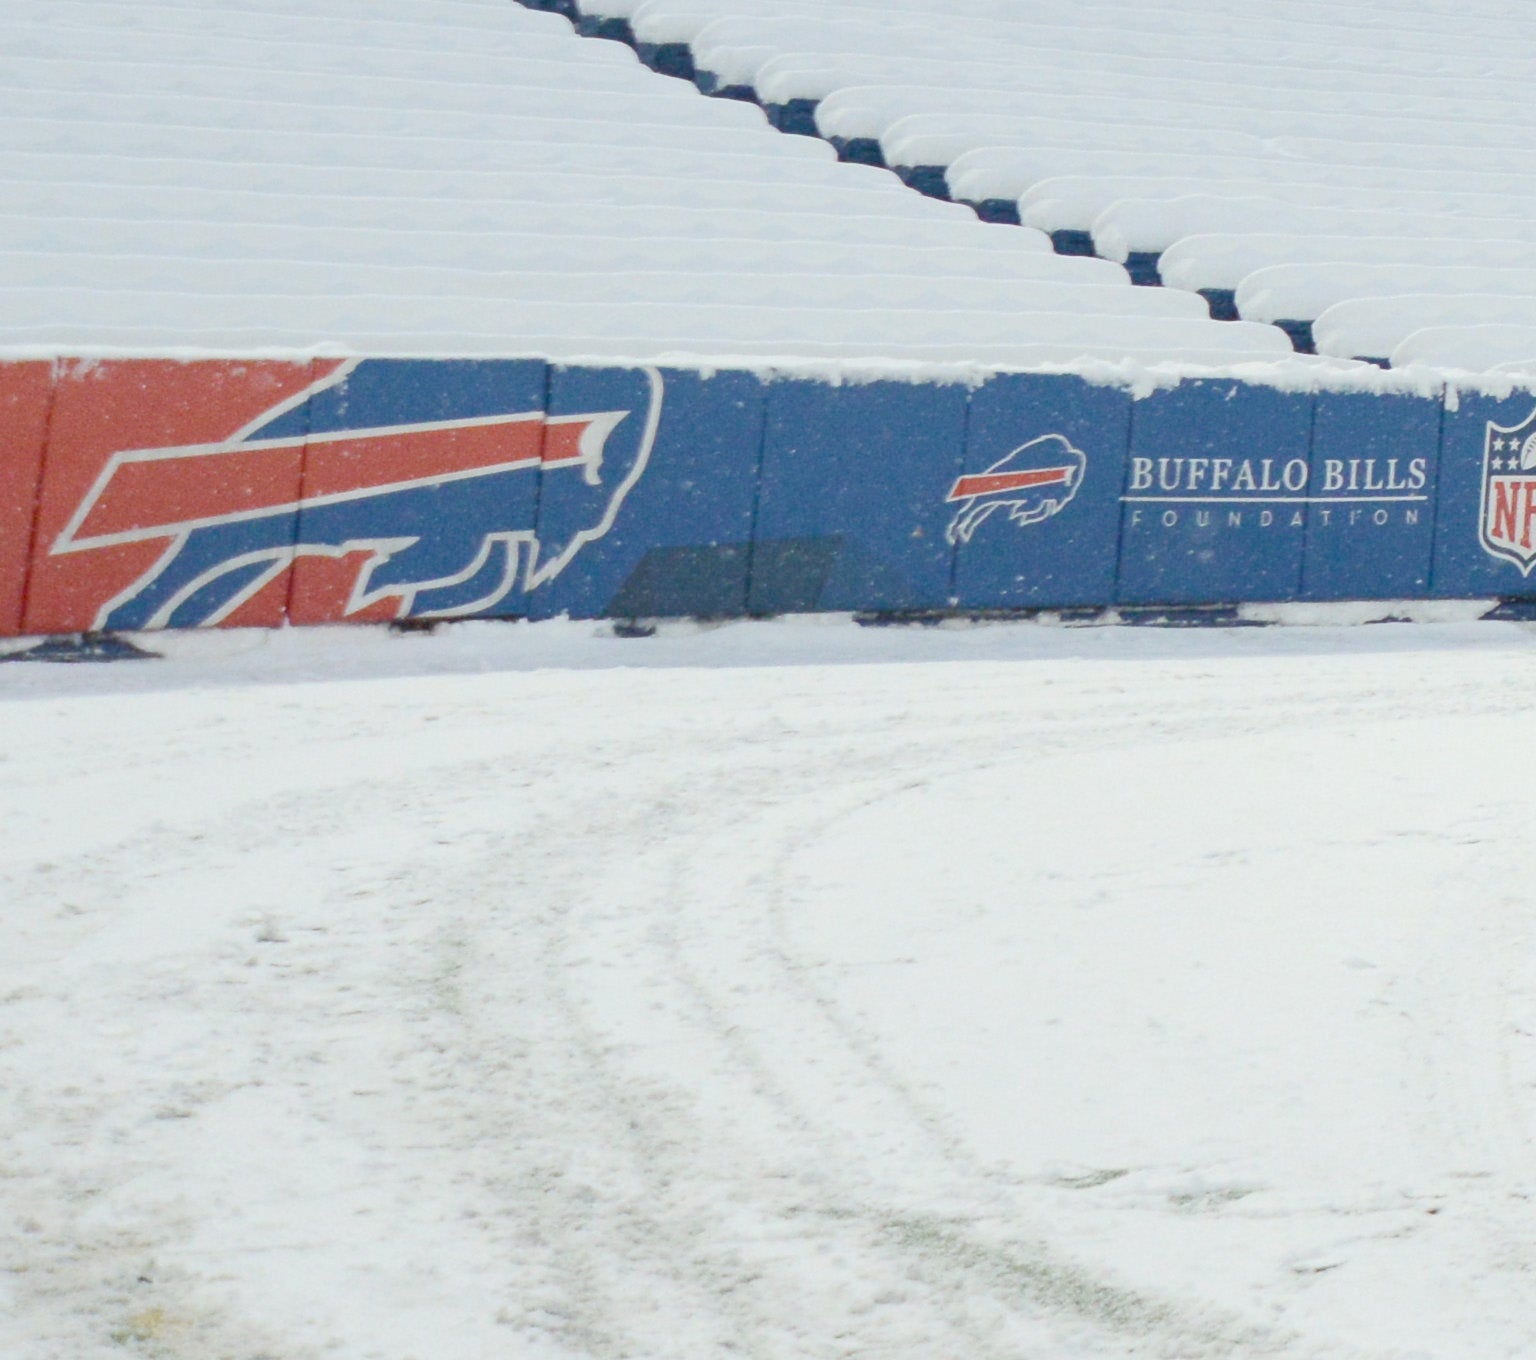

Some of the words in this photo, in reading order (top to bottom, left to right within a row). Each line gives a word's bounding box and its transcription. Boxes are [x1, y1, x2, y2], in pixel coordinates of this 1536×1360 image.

[1129, 457, 1308, 491] BUFFALO
[1322, 457, 1427, 491] BILLS
[1131, 509, 1418, 527] FOUNDATION
